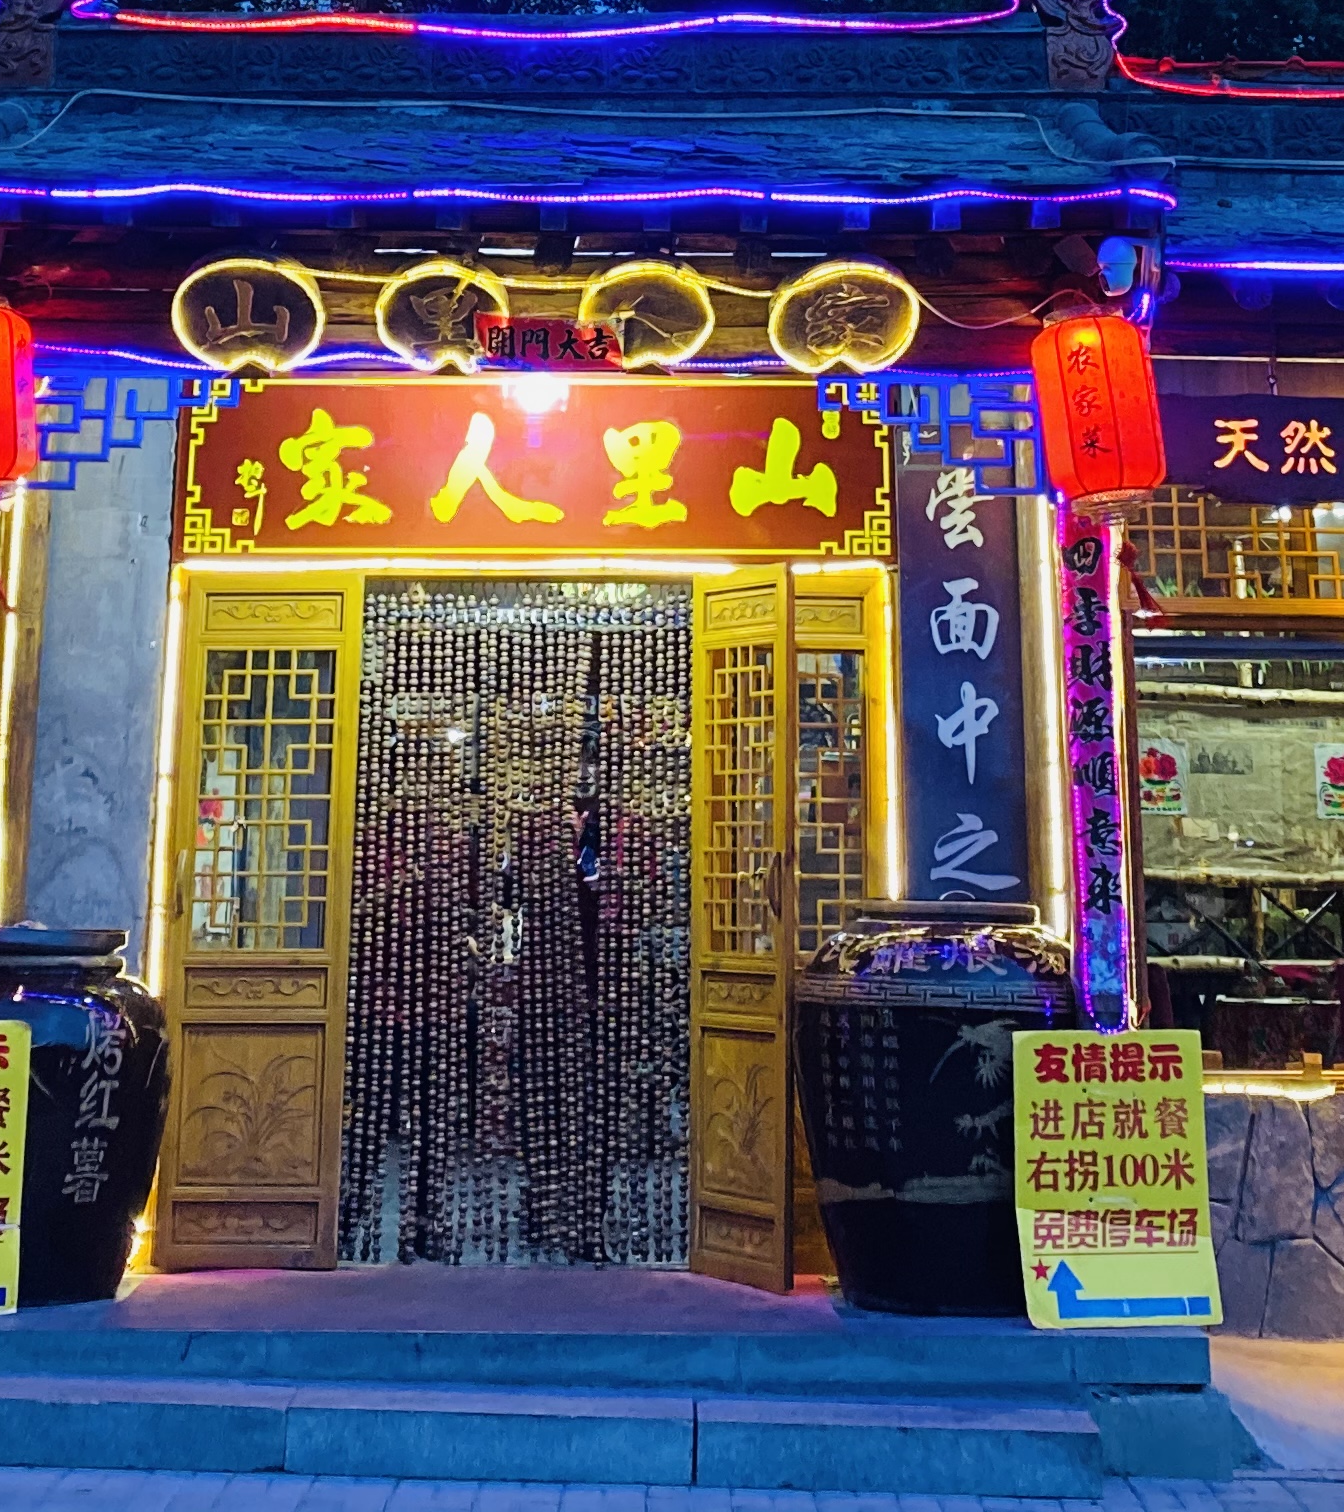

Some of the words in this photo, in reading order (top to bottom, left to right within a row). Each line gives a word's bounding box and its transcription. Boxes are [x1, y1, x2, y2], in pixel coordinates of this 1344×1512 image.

[486, 324, 614, 361] 開門大吉
[1066, 341, 1113, 460] 农家菜
[278, 407, 840, 531] 山里人家
[1033, 1042, 1184, 1085] 友情提示
[61, 1009, 127, 1205] 烤红薯
[1029, 1096, 1190, 1141] 进店就餐
[1026, 1148, 1196, 1193] 右拐100米
[1032, 1207, 1199, 1251] 免费停车场
